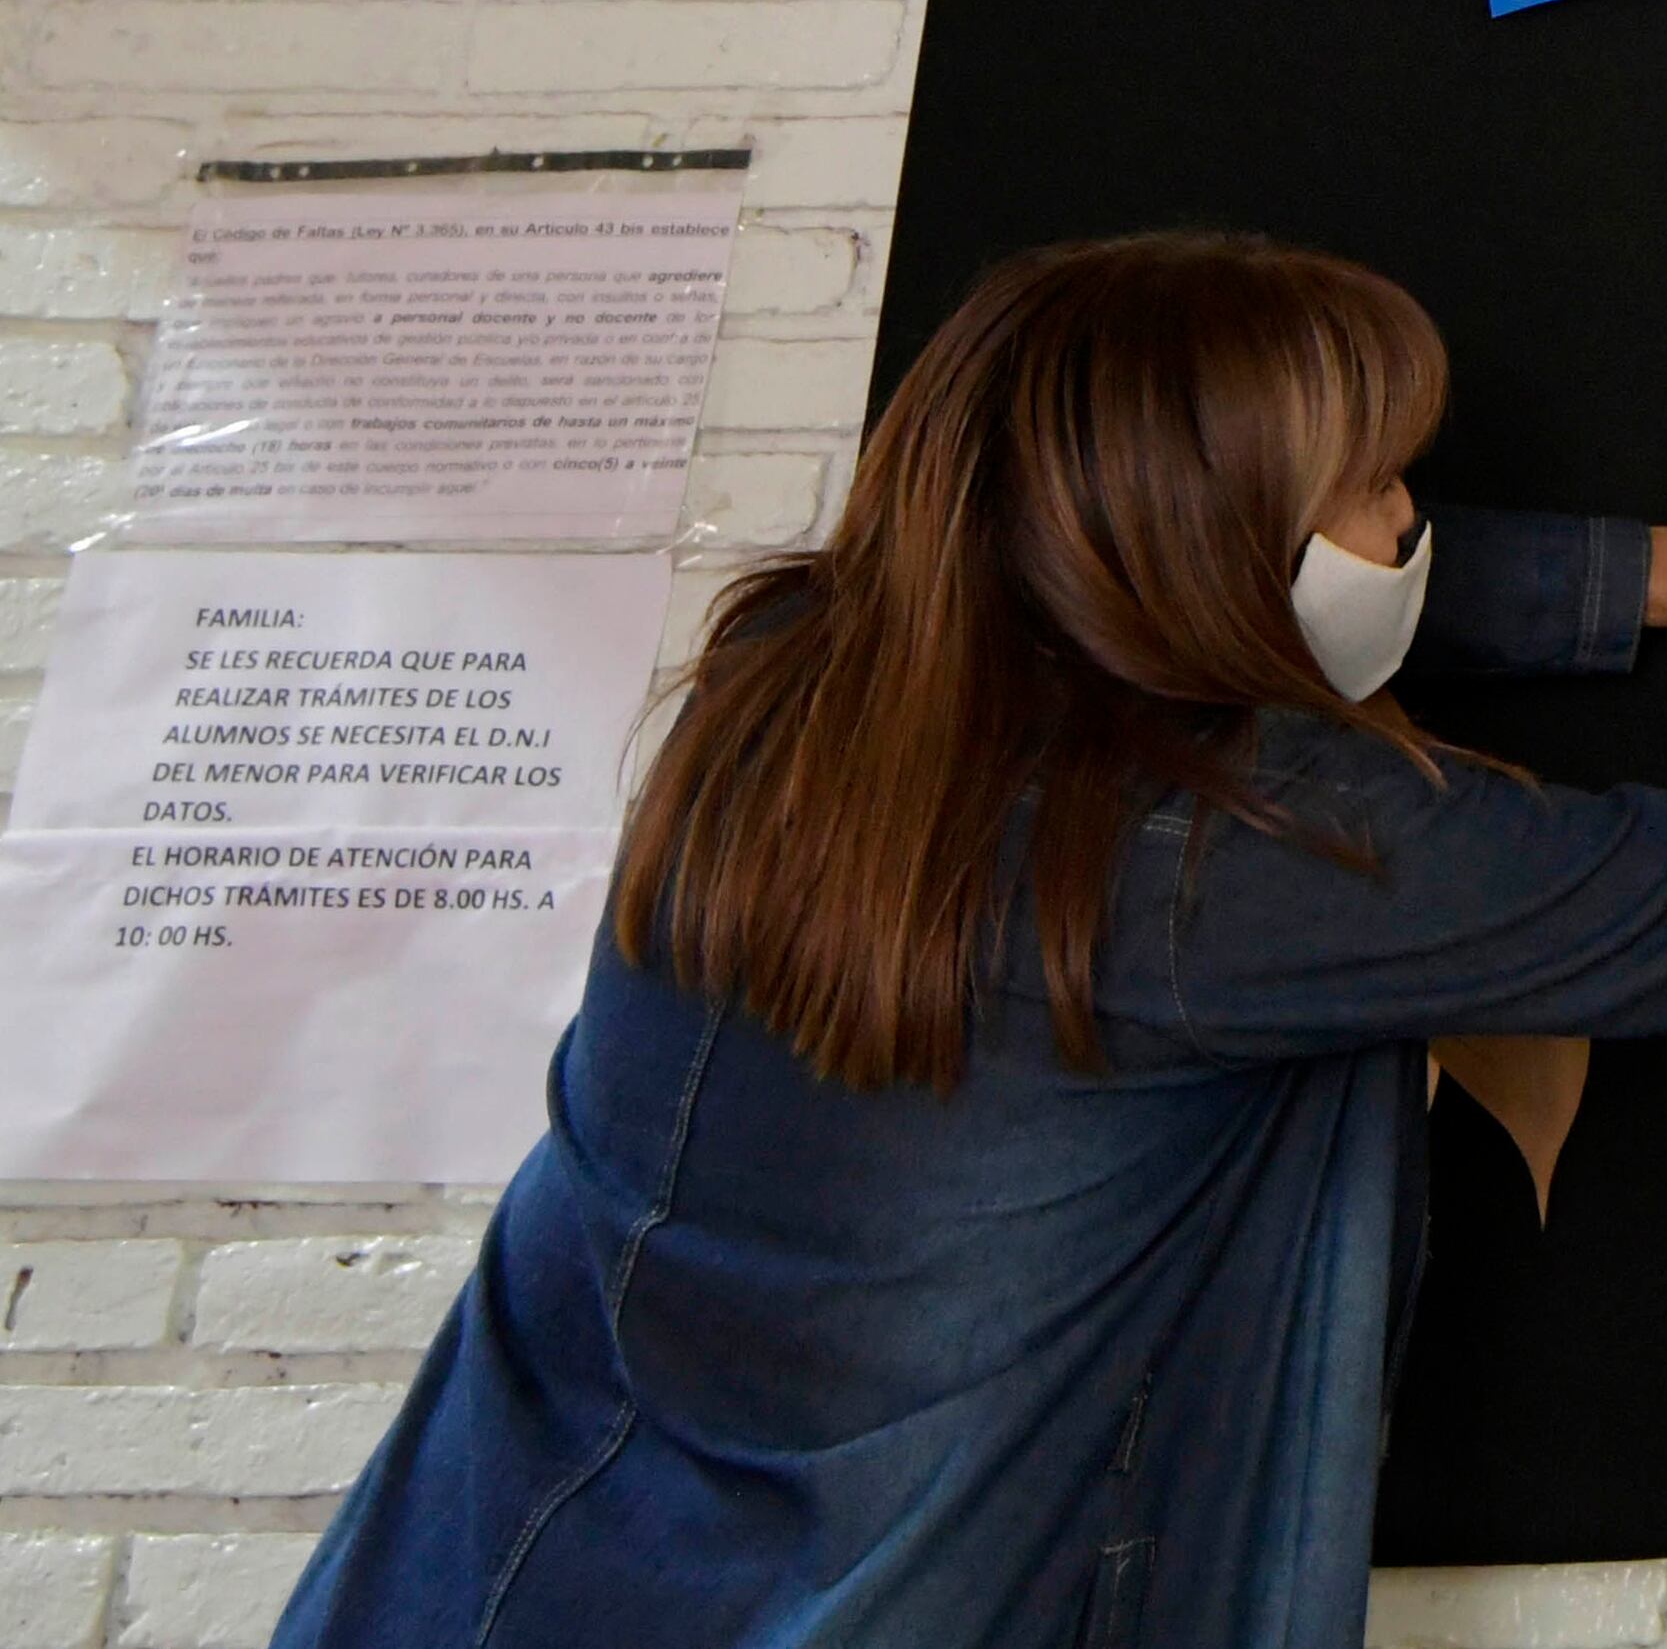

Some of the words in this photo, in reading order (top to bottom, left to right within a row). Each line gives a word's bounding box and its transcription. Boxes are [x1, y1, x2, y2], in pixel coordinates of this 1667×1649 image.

[297, 226, 345, 239] Faltas
[651, 223, 731, 235] establece
[648, 269, 722, 284] agrediere
[391, 311, 463, 325] personal
[472, 311, 538, 323] docente
[595, 311, 658, 323] docente
[351, 418, 418, 433] trabajos
[423, 417, 526, 429] comunitarios
[558, 416, 602, 427] hasta
[553, 458, 620, 473] cinco(5)
[195, 607, 305, 629] FAMILIA:
[185, 650, 214, 670] SE
[219, 649, 260, 670] LES
[265, 650, 393, 671] RECUERDA
[400, 650, 456, 673] QUE
[461, 651, 527, 672] PARA
[175, 687, 291, 708] REALIZAR
[299, 683, 419, 708] TRÁMITES
[425, 688, 460, 709] DE
[464, 689, 512, 710] LOS
[162, 724, 291, 746] ALUMNOS
[296, 725, 325, 746] SE
[330, 724, 446, 746] NECESITA
[453, 726, 480, 747] EL
[487, 727, 551, 748] D.N.I
[151, 762, 196, 783] DEL
[204, 763, 301, 784] MENOR
[306, 763, 370, 784] PARA
[380, 763, 508, 786] VERIFICAR
[513, 766, 563, 788] LOS
[142, 801, 233, 823] DATOS.
[131, 845, 156, 867] EL
[163, 845, 282, 868] HORARIO
[289, 846, 322, 868] DE
[326, 842, 458, 869] ATENCIÓN
[464, 848, 532, 871] PARA
[122, 885, 216, 907] DICHOS
[224, 882, 350, 909] TRÁMITES
[357, 887, 386, 909] ES
[394, 887, 427, 910] DE
[433, 888, 486, 910] 8.00
[491, 889, 530, 911] HS.
[536, 890, 555, 910] A
[192, 925, 233, 947] HS.
